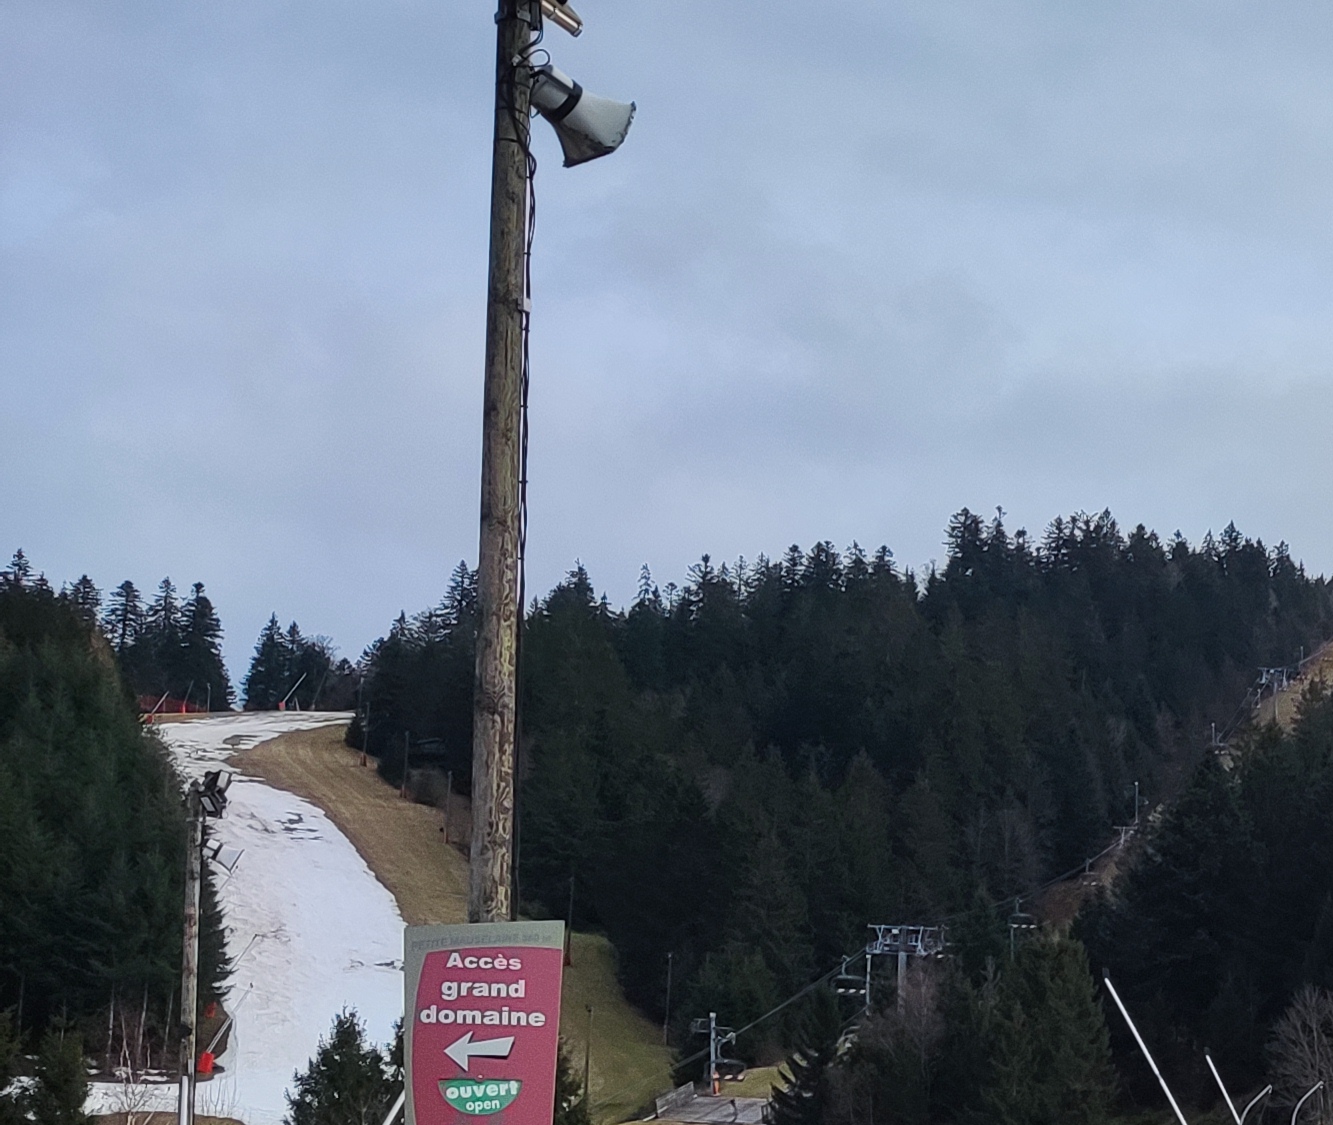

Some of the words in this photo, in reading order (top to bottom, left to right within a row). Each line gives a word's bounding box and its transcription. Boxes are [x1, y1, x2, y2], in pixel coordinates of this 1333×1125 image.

[445, 952, 522, 970] Accès
[441, 980, 526, 1001] grand
[420, 1004, 546, 1027] domaine
[445, 1080, 519, 1099] ouvert
[465, 1099, 501, 1114] open
